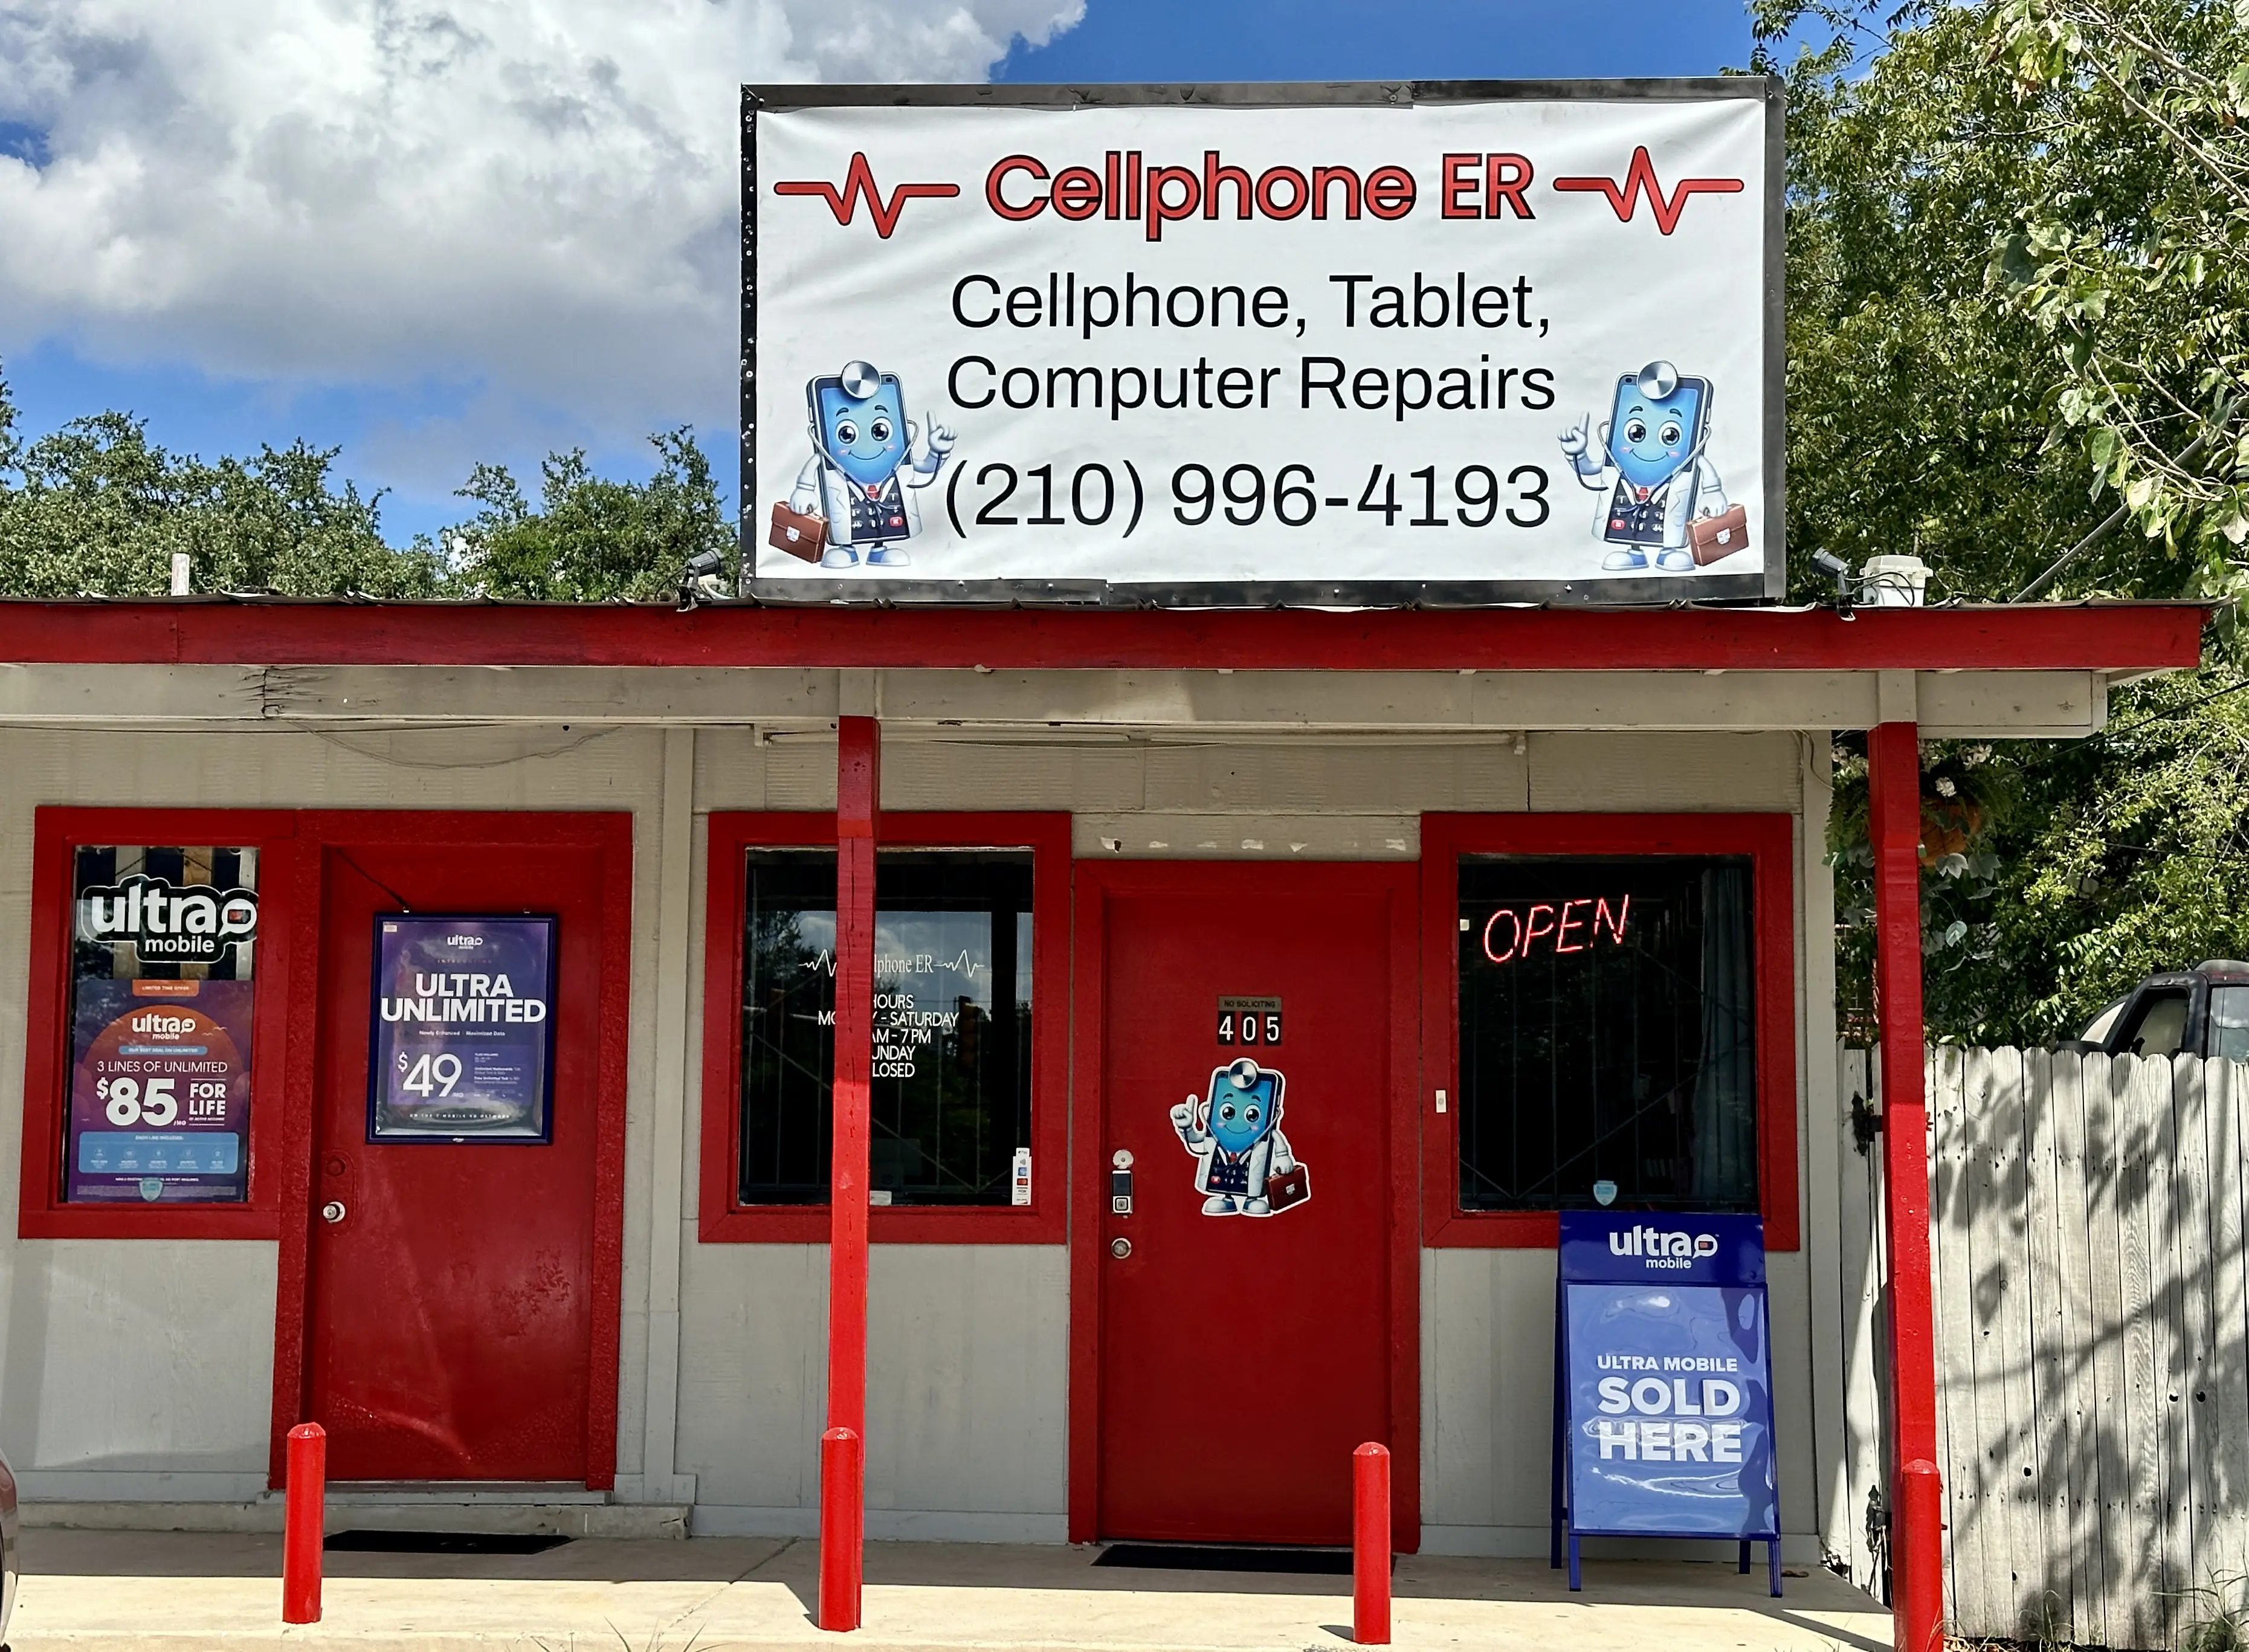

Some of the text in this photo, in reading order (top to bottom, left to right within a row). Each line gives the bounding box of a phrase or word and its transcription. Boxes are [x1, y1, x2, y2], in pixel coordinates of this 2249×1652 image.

[986, 150, 1535, 242] Cellphone ER
[953, 273, 1548, 339] Cellphone, Tablet,
[949, 354, 1554, 421] Computer Repairs
[946, 460, 1549, 538] (210) 996-4193
[91, 885, 216, 934] ultra
[447, 934, 474, 946] ultra
[1483, 894, 1630, 963] OPEN
[145, 935, 215, 953] mobile
[915, 954, 934, 973] ER
[415, 973, 514, 997] ULTRA
[381, 998, 546, 1022] UNLIMITED
[1236, 1000, 1276, 1008] SOLICITING
[132, 1013, 181, 1033] ultra
[890, 1011, 959, 1027] SATURDAY
[1219, 1015, 1279, 1041] 405
[872, 1045, 916, 1060] UNDAY
[97, 1061, 228, 1073] 3 LINES OF UNLIMITED
[398, 1051, 462, 1097] $49
[872, 1062, 915, 1077] LOSED
[96, 1077, 178, 1126] $85
[190, 1083, 226, 1098] FOR
[189, 1100, 225, 1115] LIFE
[1609, 1225, 1692, 1257] ultra
[1645, 1256, 1692, 1270] mobile
[1597, 1354, 1737, 1372] ULTRA MOBILE
[1598, 1376, 1740, 1416] SOLD
[1599, 1421, 1742, 1463] HERE
